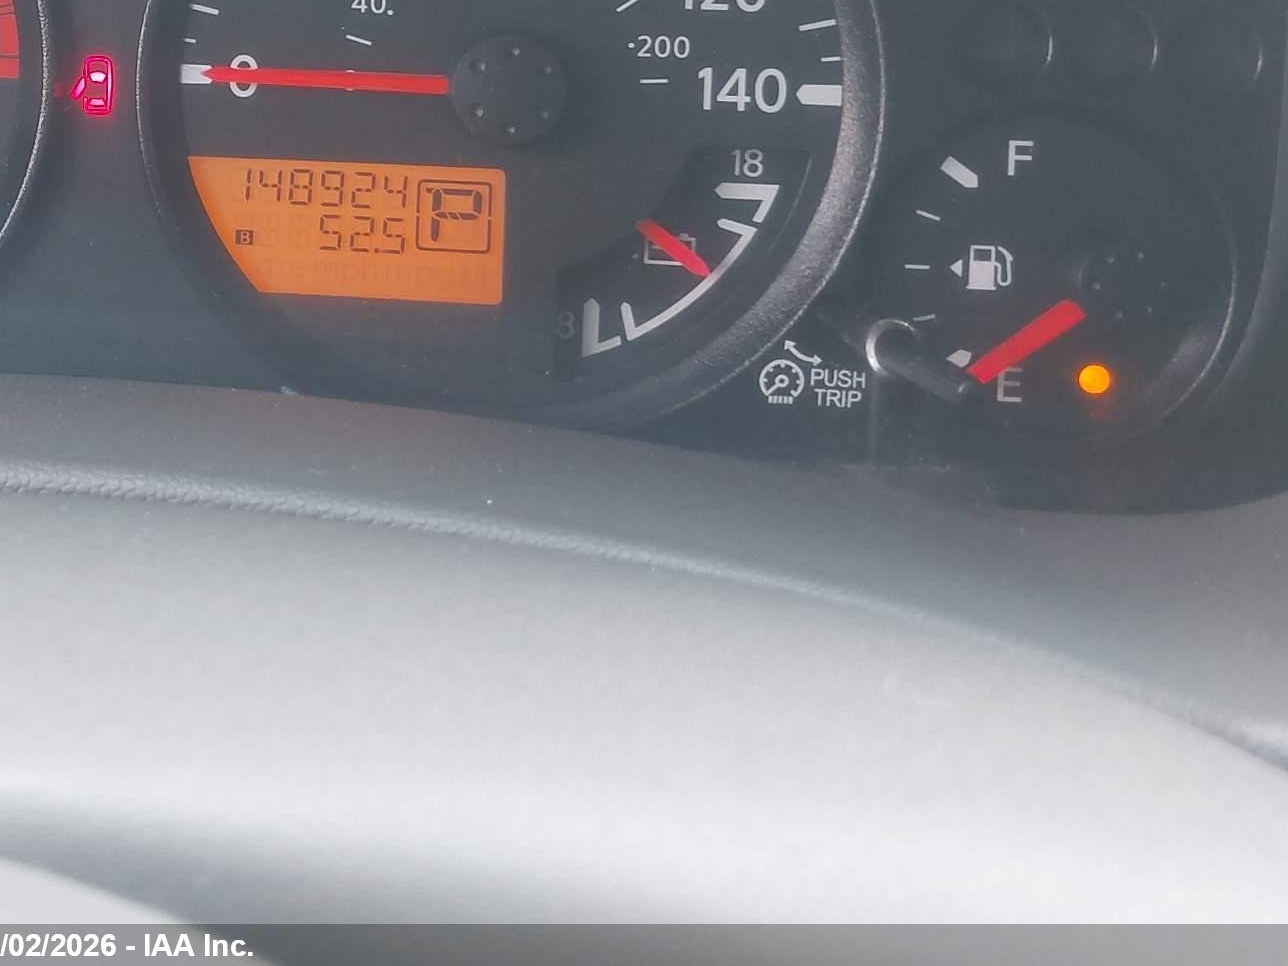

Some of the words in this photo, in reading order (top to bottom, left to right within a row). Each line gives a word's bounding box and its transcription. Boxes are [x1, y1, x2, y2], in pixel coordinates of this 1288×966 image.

[637, 35, 690, 59] 200
[229, 54, 259, 98] 0
[698, 67, 787, 114] 140
[732, 149, 764, 177] 18
[1007, 140, 1034, 176] F
[244, 169, 409, 209] 148924
[425, 187, 482, 242] P
[319, 214, 405, 254] 52.5
[810, 368, 866, 390] PUSH
[996, 368, 1022, 403] E
[813, 389, 862, 408] TRIP
